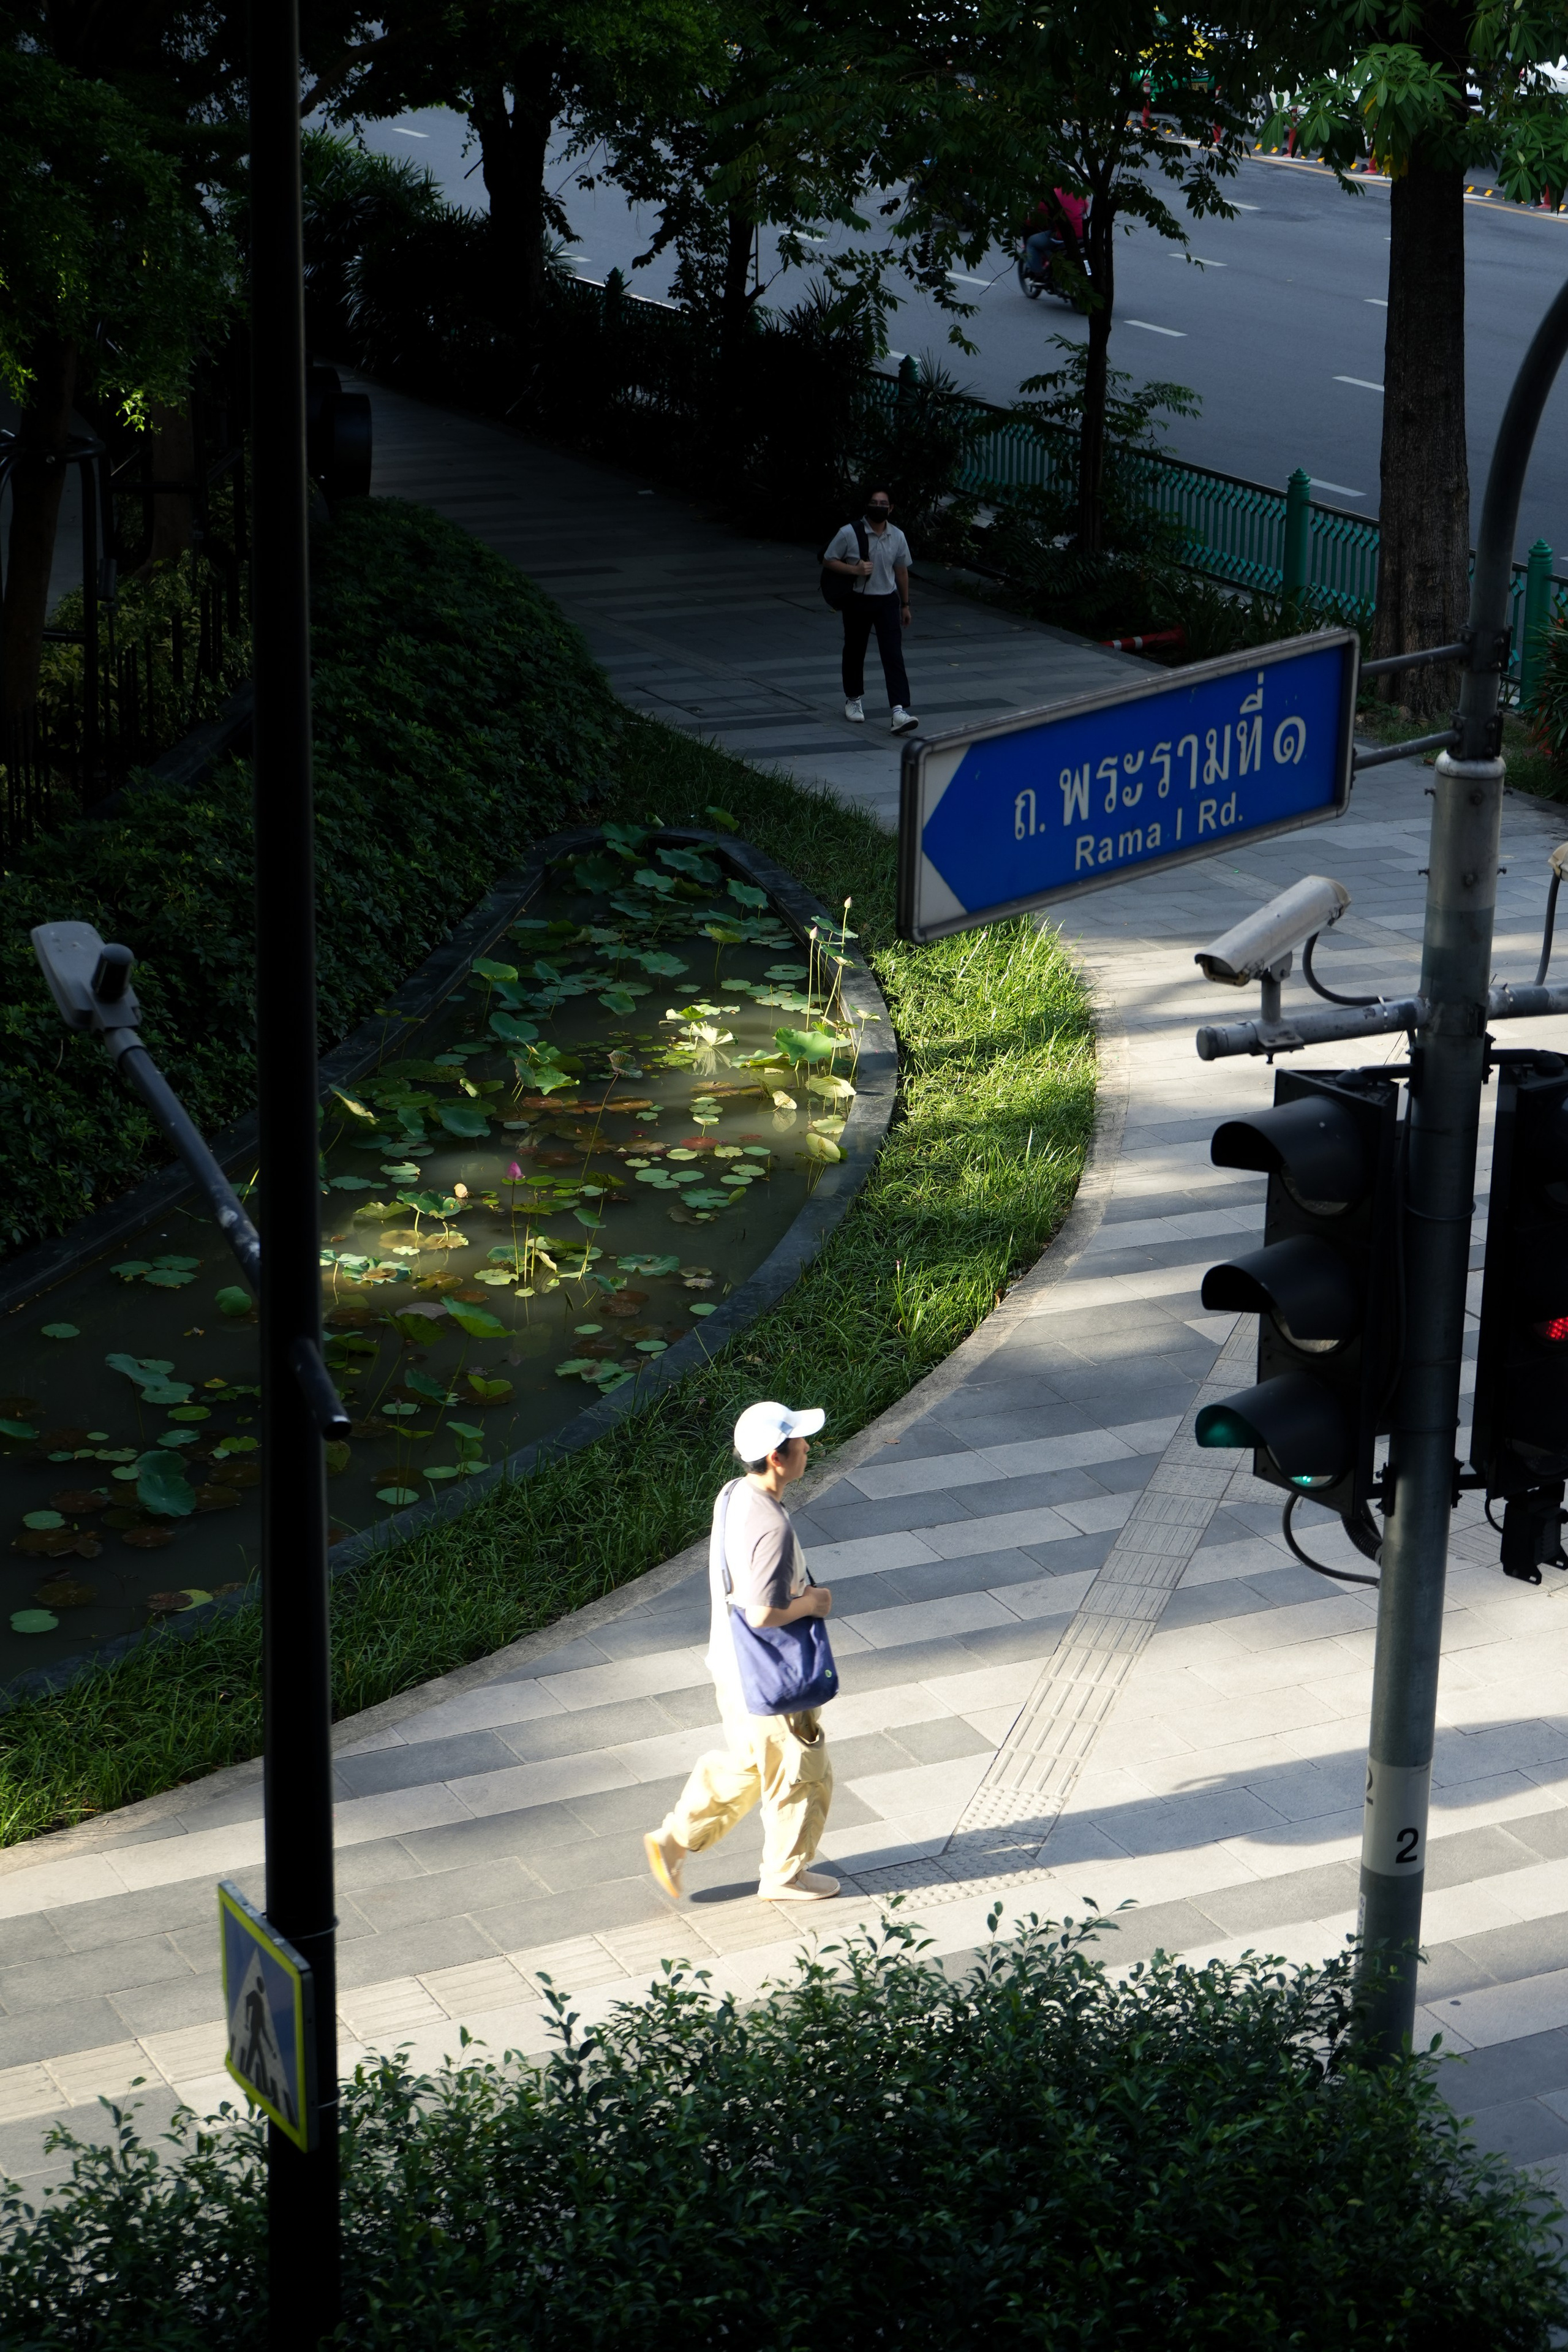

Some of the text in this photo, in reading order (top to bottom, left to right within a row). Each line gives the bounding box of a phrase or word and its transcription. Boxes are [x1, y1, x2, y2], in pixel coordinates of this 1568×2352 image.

[1075, 823, 1161, 870] Rama
[1198, 791, 1243, 834] Rd.
[1395, 1827, 1419, 1864] 2
